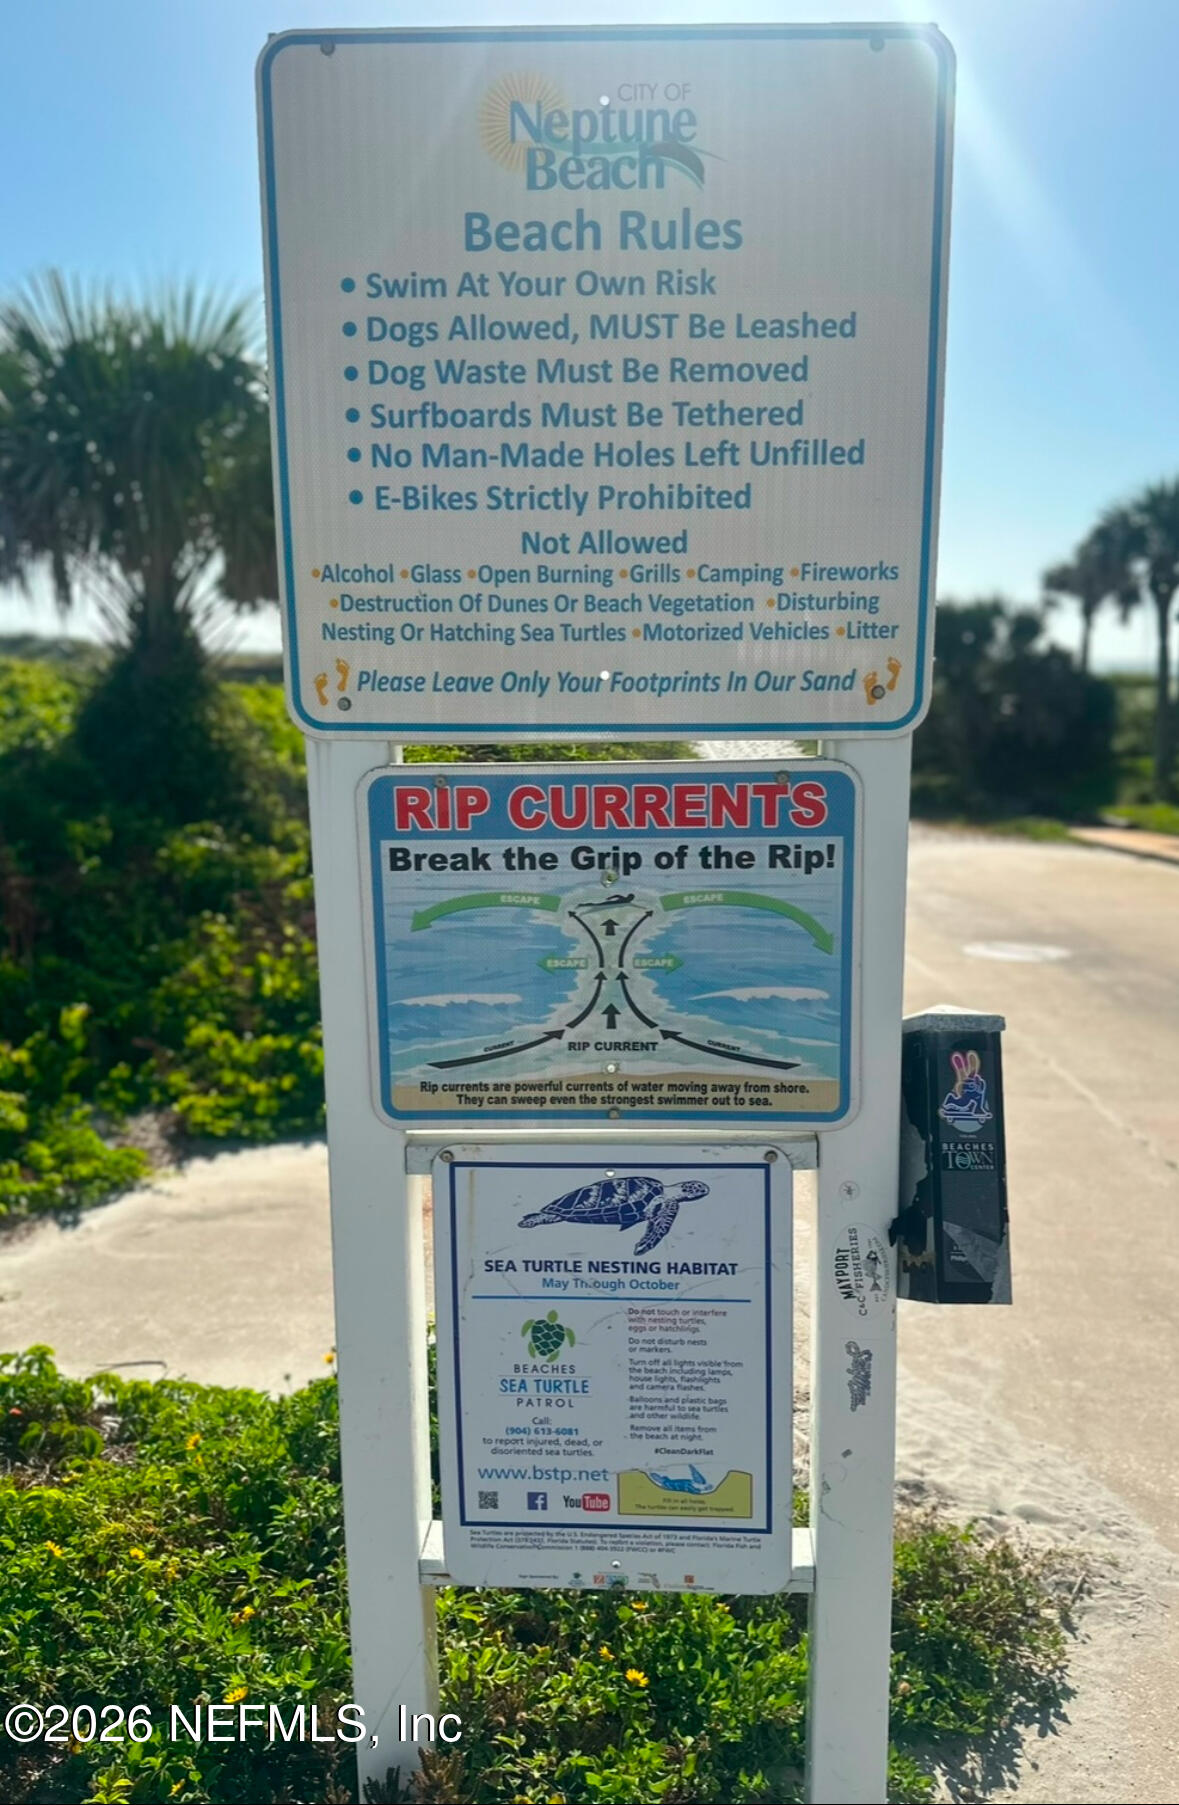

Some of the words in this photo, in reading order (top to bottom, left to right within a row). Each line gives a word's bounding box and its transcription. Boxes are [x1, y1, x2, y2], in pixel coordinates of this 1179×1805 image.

[617, 83, 658, 102] CITY
[664, 82, 691, 101] OF
[509, 100, 697, 156] Neptune
[526, 144, 665, 190] Beach
[464, 208, 601, 252] Beach
[620, 207, 742, 250] Rules
[366, 271, 446, 298] Swim
[456, 271, 489, 297] At
[498, 271, 566, 296] Your
[576, 270, 644, 296] Own
[656, 268, 716, 295] Risk
[367, 316, 438, 347] Dogs
[448, 313, 578, 344] Allowed,
[590, 313, 679, 339] MUST
[689, 313, 725, 339] Be
[736, 311, 856, 338] Leashed
[368, 360, 425, 391] Dog
[434, 359, 526, 384] Waste
[537, 358, 612, 383] Must
[623, 357, 658, 383] Be
[670, 354, 808, 382] Removed
[370, 401, 531, 428] Surfboards
[542, 402, 616, 427] Must
[627, 402, 663, 427] Be
[672, 399, 803, 426] Tethered
[371, 443, 412, 468] No
[422, 441, 584, 468] Man-Made
[594, 440, 674, 467] Holes
[685, 439, 740, 466] Left
[750, 438, 864, 466] Unfilled
[375, 484, 478, 510] E-Bikes
[486, 484, 588, 516] Strictly
[598, 482, 751, 510] Prohibited
[522, 531, 570, 554] Not
[578, 529, 687, 554] Allowed
[321, 563, 394, 583] Alcohol
[410, 563, 461, 583] Glass
[478, 564, 530, 588] Open
[537, 564, 613, 588] Burning
[630, 563, 680, 583] Grills
[697, 563, 784, 586] Camping
[801, 561, 898, 581] Fireworks
[340, 593, 452, 612] Destruction
[459, 592, 482, 612] Of
[488, 594, 548, 612] Dunes
[554, 594, 578, 612] Or
[584, 592, 642, 612] Beach
[648, 592, 754, 616] Vegetation
[777, 591, 879, 614] Disturbing
[322, 622, 395, 645] Nesting
[400, 623, 424, 641] Or
[430, 622, 515, 645] Hatching
[520, 623, 554, 641] Sea
[560, 622, 626, 641] Turtles
[643, 621, 743, 641] Motorized
[749, 621, 829, 640] Vehicles
[846, 620, 899, 639] Litter
[357, 670, 426, 692] Please
[432, 671, 494, 692] Leave
[500, 670, 550, 697] Only
[557, 671, 604, 692] Your
[609, 670, 720, 697] Footprints
[727, 670, 747, 691] In
[754, 670, 796, 691] Our
[800, 669, 856, 691] Sand
[393, 786, 490, 831] RIP
[508, 782, 828, 830] CURRENTS
[389, 847, 491, 871] Break
[502, 846, 558, 870] the
[570, 845, 642, 877] Grip
[654, 844, 688, 870] of
[698, 845, 755, 869] the
[768, 844, 834, 874] Rip!
[501, 894, 541, 905] ESCAPE
[683, 893, 724, 904] ESCAPE
[546, 958, 587, 968] ESCAPE
[634, 957, 675, 968] ESCAPE
[568, 1042, 590, 1051] RIP
[594, 1041, 658, 1051] CURRENT
[420, 1081, 438, 1094] Rip
[441, 1081, 490, 1094] currents
[492, 1083, 511, 1092] are
[514, 1081, 562, 1094] powerful
[565, 1081, 614, 1094] currents
[617, 1081, 628, 1091] of
[631, 1081, 664, 1092] water
[667, 1081, 707, 1095] moving
[710, 1084, 741, 1095] away
[743, 1081, 770, 1093] from
[773, 1082, 809, 1093] shore.
[456, 1094, 484, 1107] They
[487, 1096, 507, 1104] can
[510, 1096, 546, 1107] sweep
[549, 1096, 576, 1104] even
[579, 1094, 597, 1104] the
[600, 1094, 654, 1107] strongest
[657, 1094, 708, 1105] swimmer
[712, 1095, 730, 1105] out
[733, 1095, 745, 1105] to
[748, 1097, 772, 1106] sea.
[942, 1150, 994, 1169] TOWN
[484, 1260, 517, 1272] SEA
[522, 1260, 582, 1272] TURTLE
[588, 1261, 660, 1274] NESTING
[667, 1262, 738, 1275] HABITAT
[847, 1227, 864, 1289] FISHERIES
[542, 1278, 569, 1290] May
[629, 1279, 680, 1290] October
[834, 1247, 857, 1300] MAYPORT
[514, 1364, 575, 1374] BEACHES
[499, 1378, 527, 1392] SEA
[533, 1379, 588, 1393] TURTLE
[516, 1398, 573, 1408] PATROL
[531, 1416, 551, 1425] Call:
[478, 1465, 608, 1482] www.bstp.net
